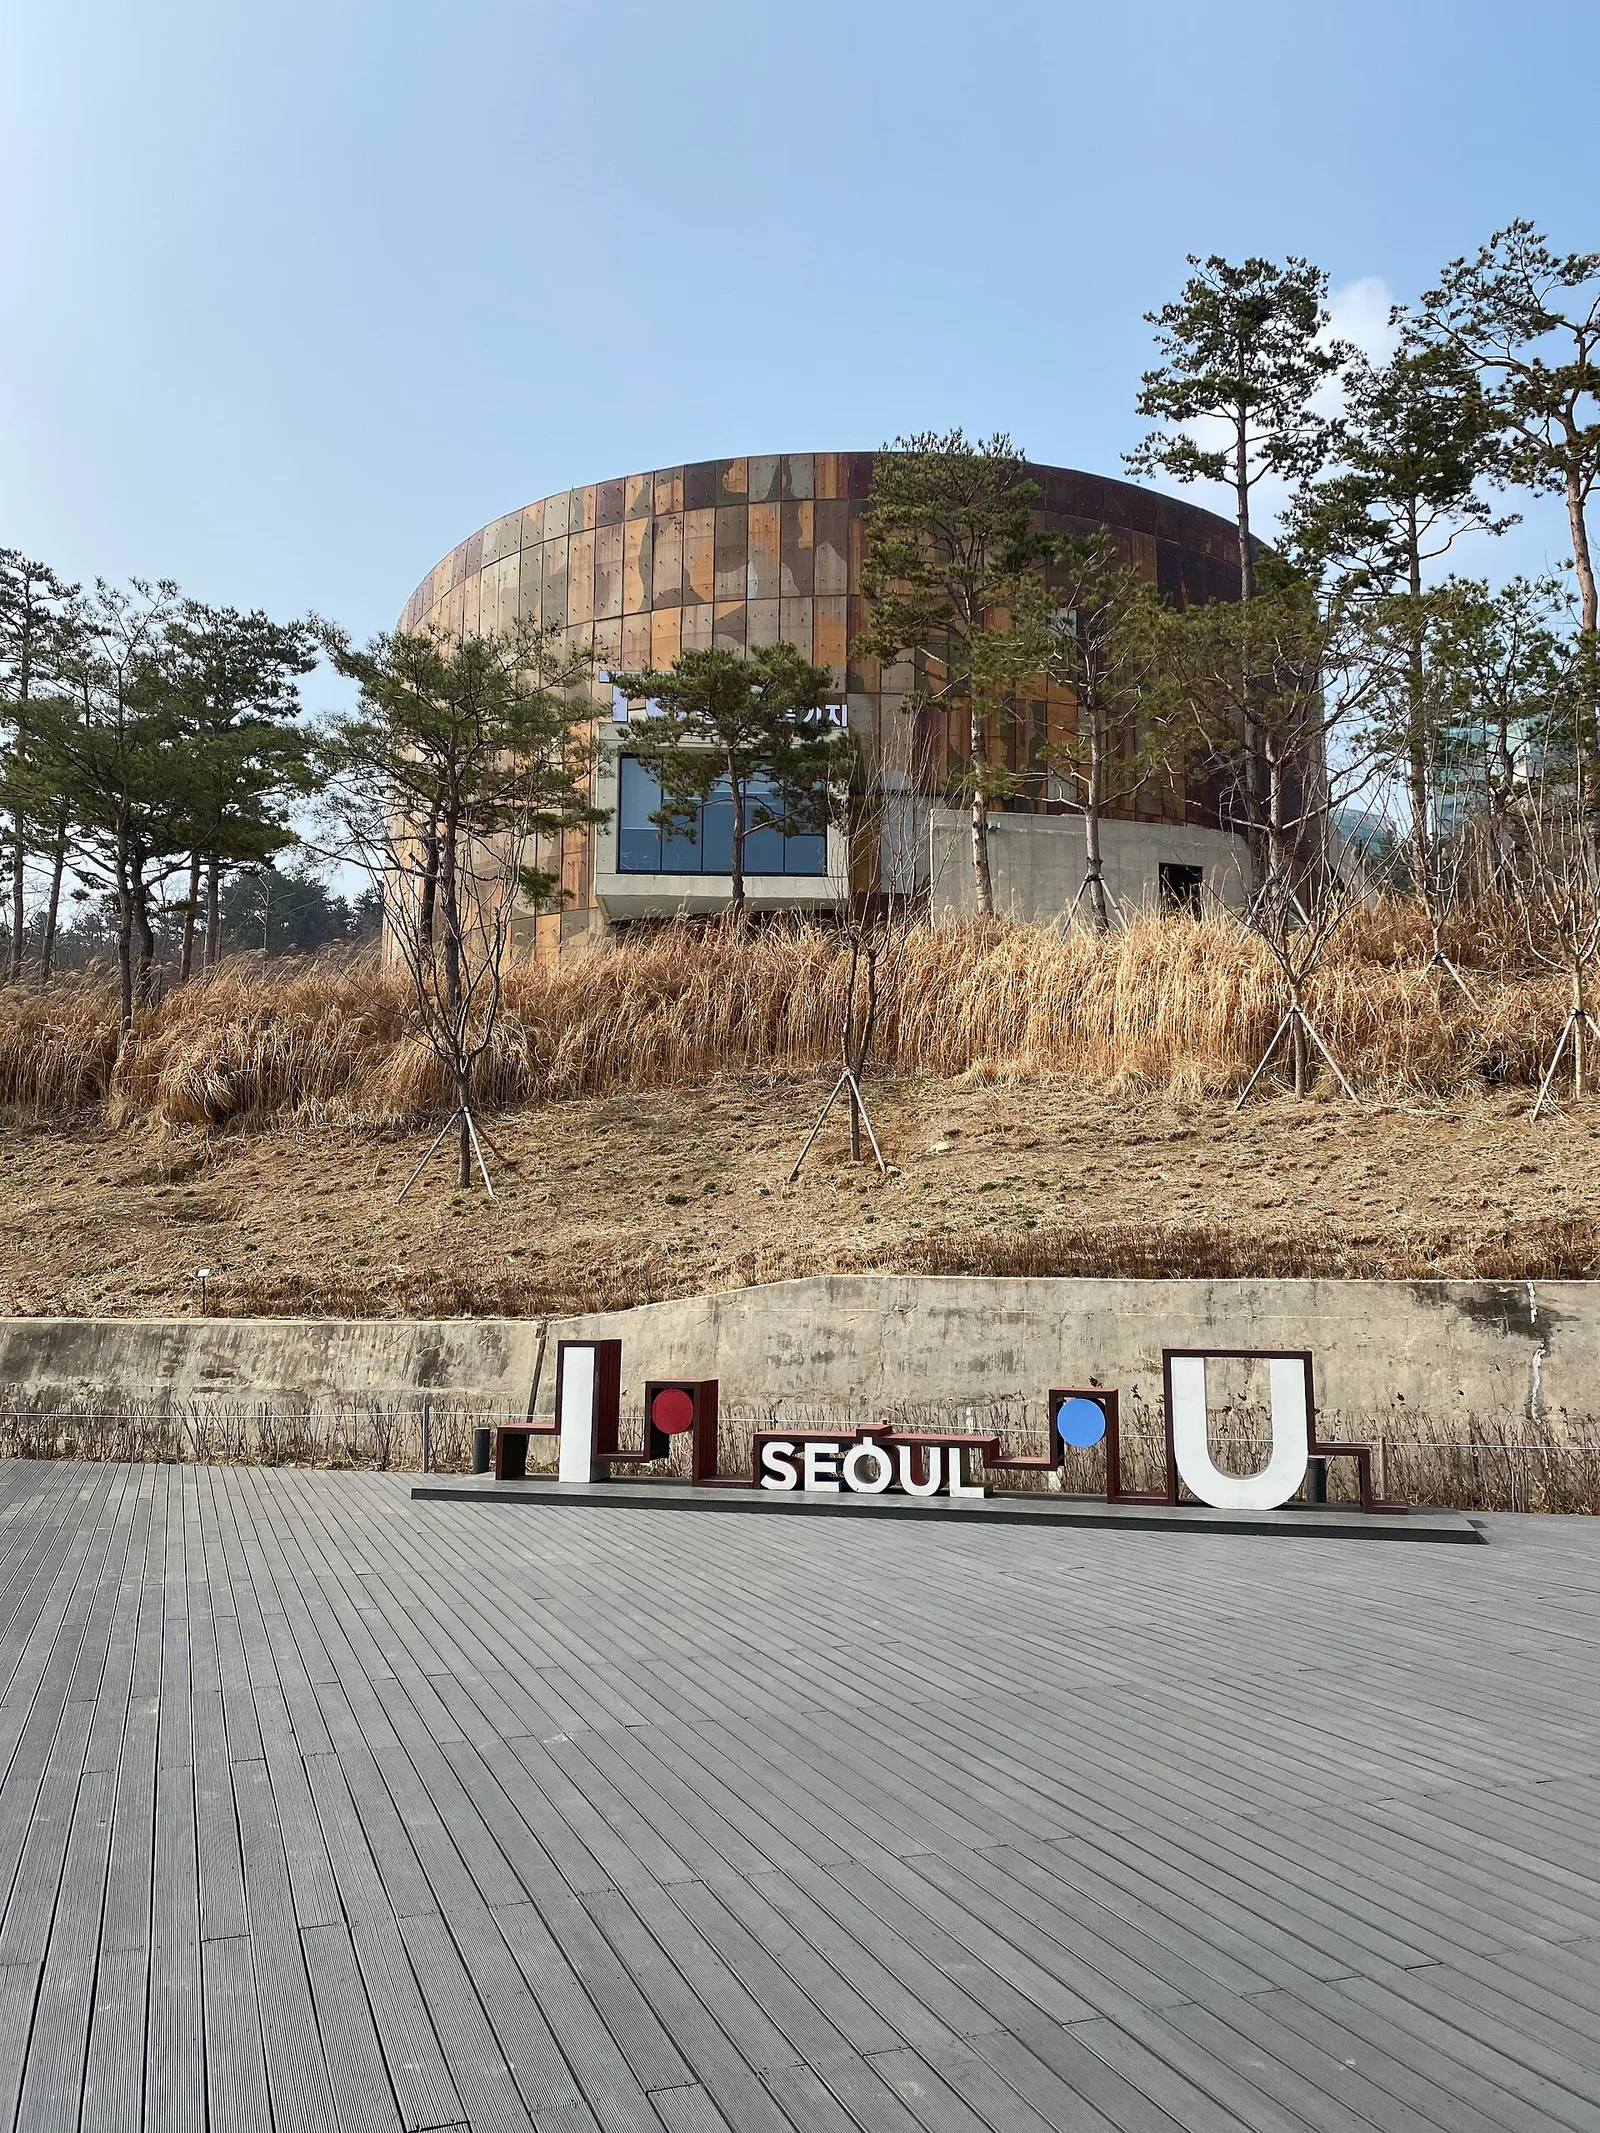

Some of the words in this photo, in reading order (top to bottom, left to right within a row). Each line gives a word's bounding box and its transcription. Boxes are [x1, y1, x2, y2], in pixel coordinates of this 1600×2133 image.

[559, 1347, 595, 1483] I
[760, 1437, 985, 1498] SEOUL
[1171, 1357, 1308, 1511] U
